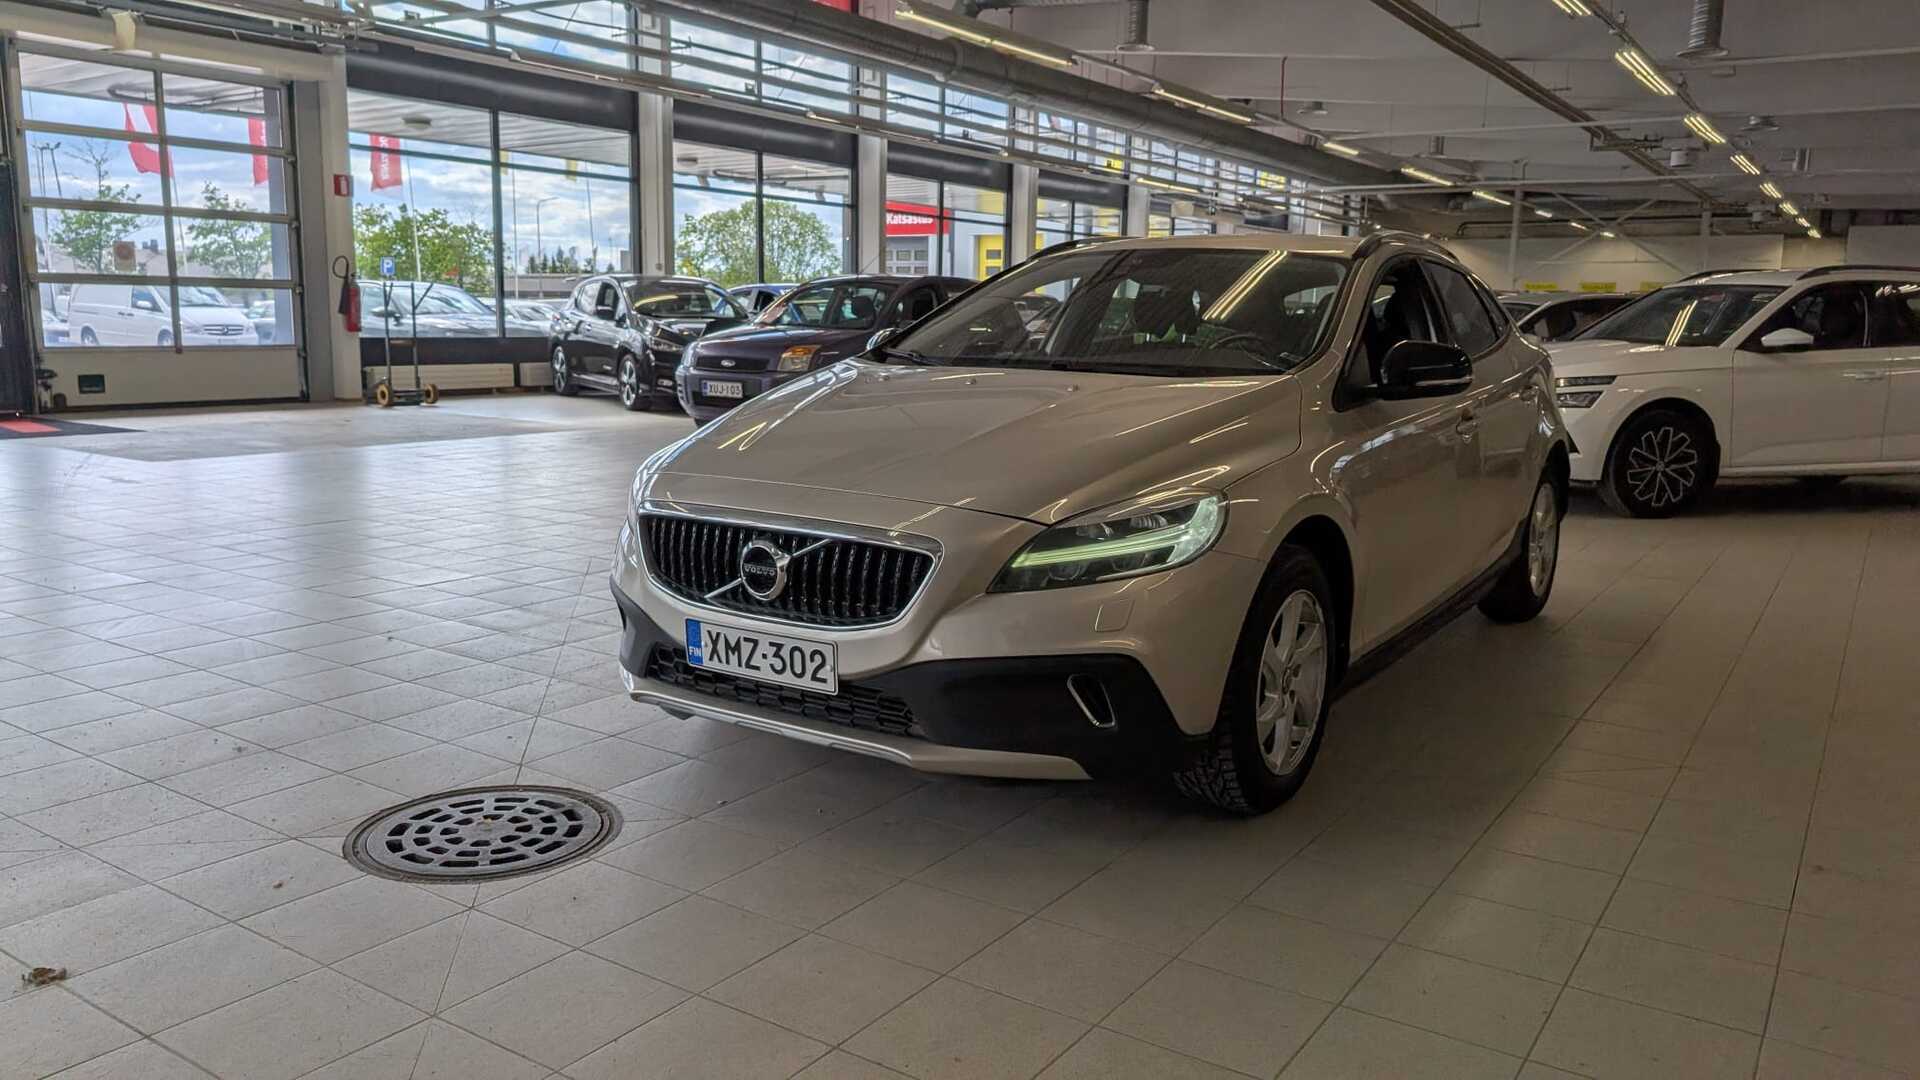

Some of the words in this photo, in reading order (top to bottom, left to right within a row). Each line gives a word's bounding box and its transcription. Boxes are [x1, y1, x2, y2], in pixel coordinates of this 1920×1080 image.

[383, 259, 393, 273] P
[744, 565, 775, 576] VOLVO
[688, 646, 703, 657] FIN
[706, 629, 828, 684] XMZ-302
